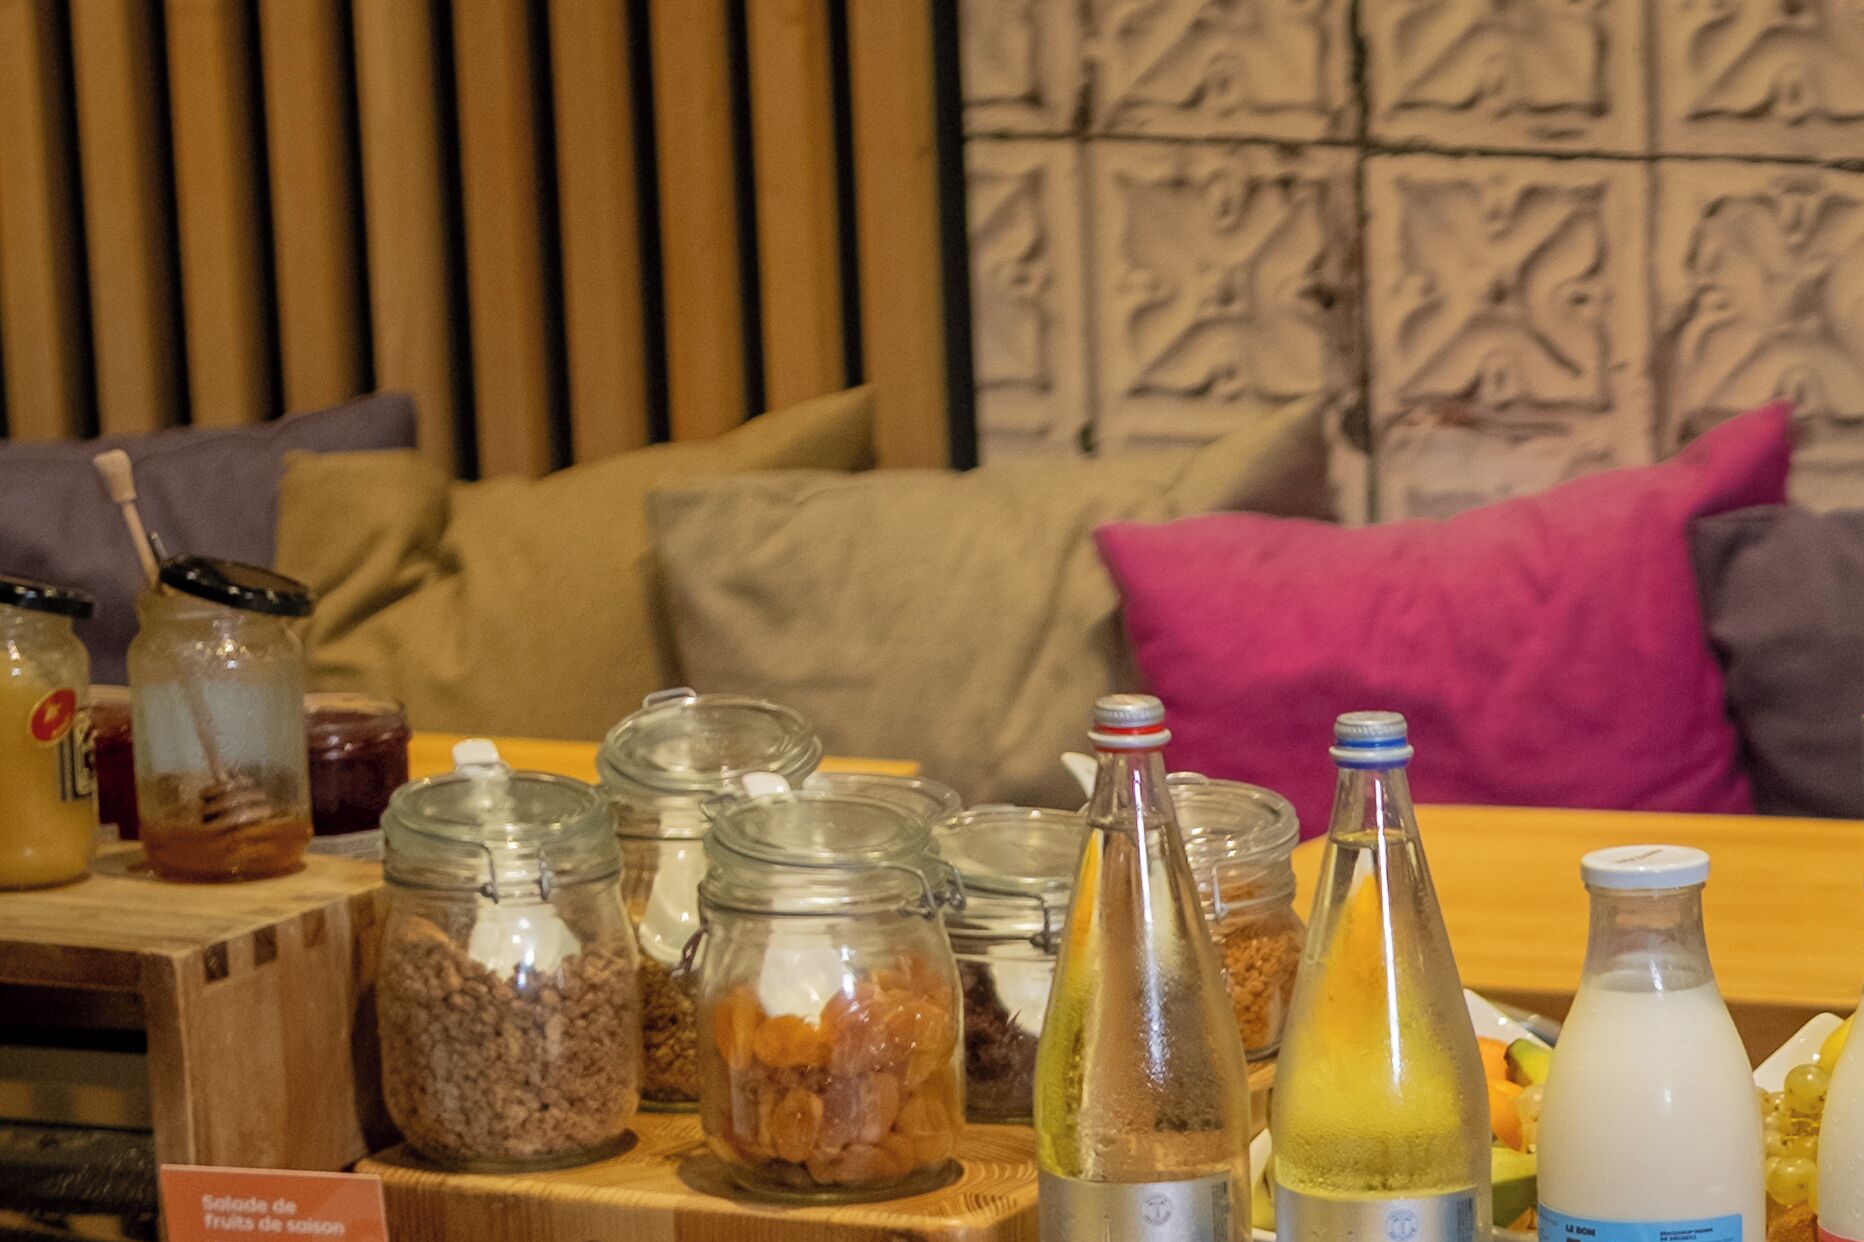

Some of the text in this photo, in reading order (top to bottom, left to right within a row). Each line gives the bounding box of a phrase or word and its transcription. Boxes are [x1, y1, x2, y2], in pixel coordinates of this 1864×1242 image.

[202, 1194, 297, 1215] Salade de
[204, 1212, 345, 1236] fruits de saison
